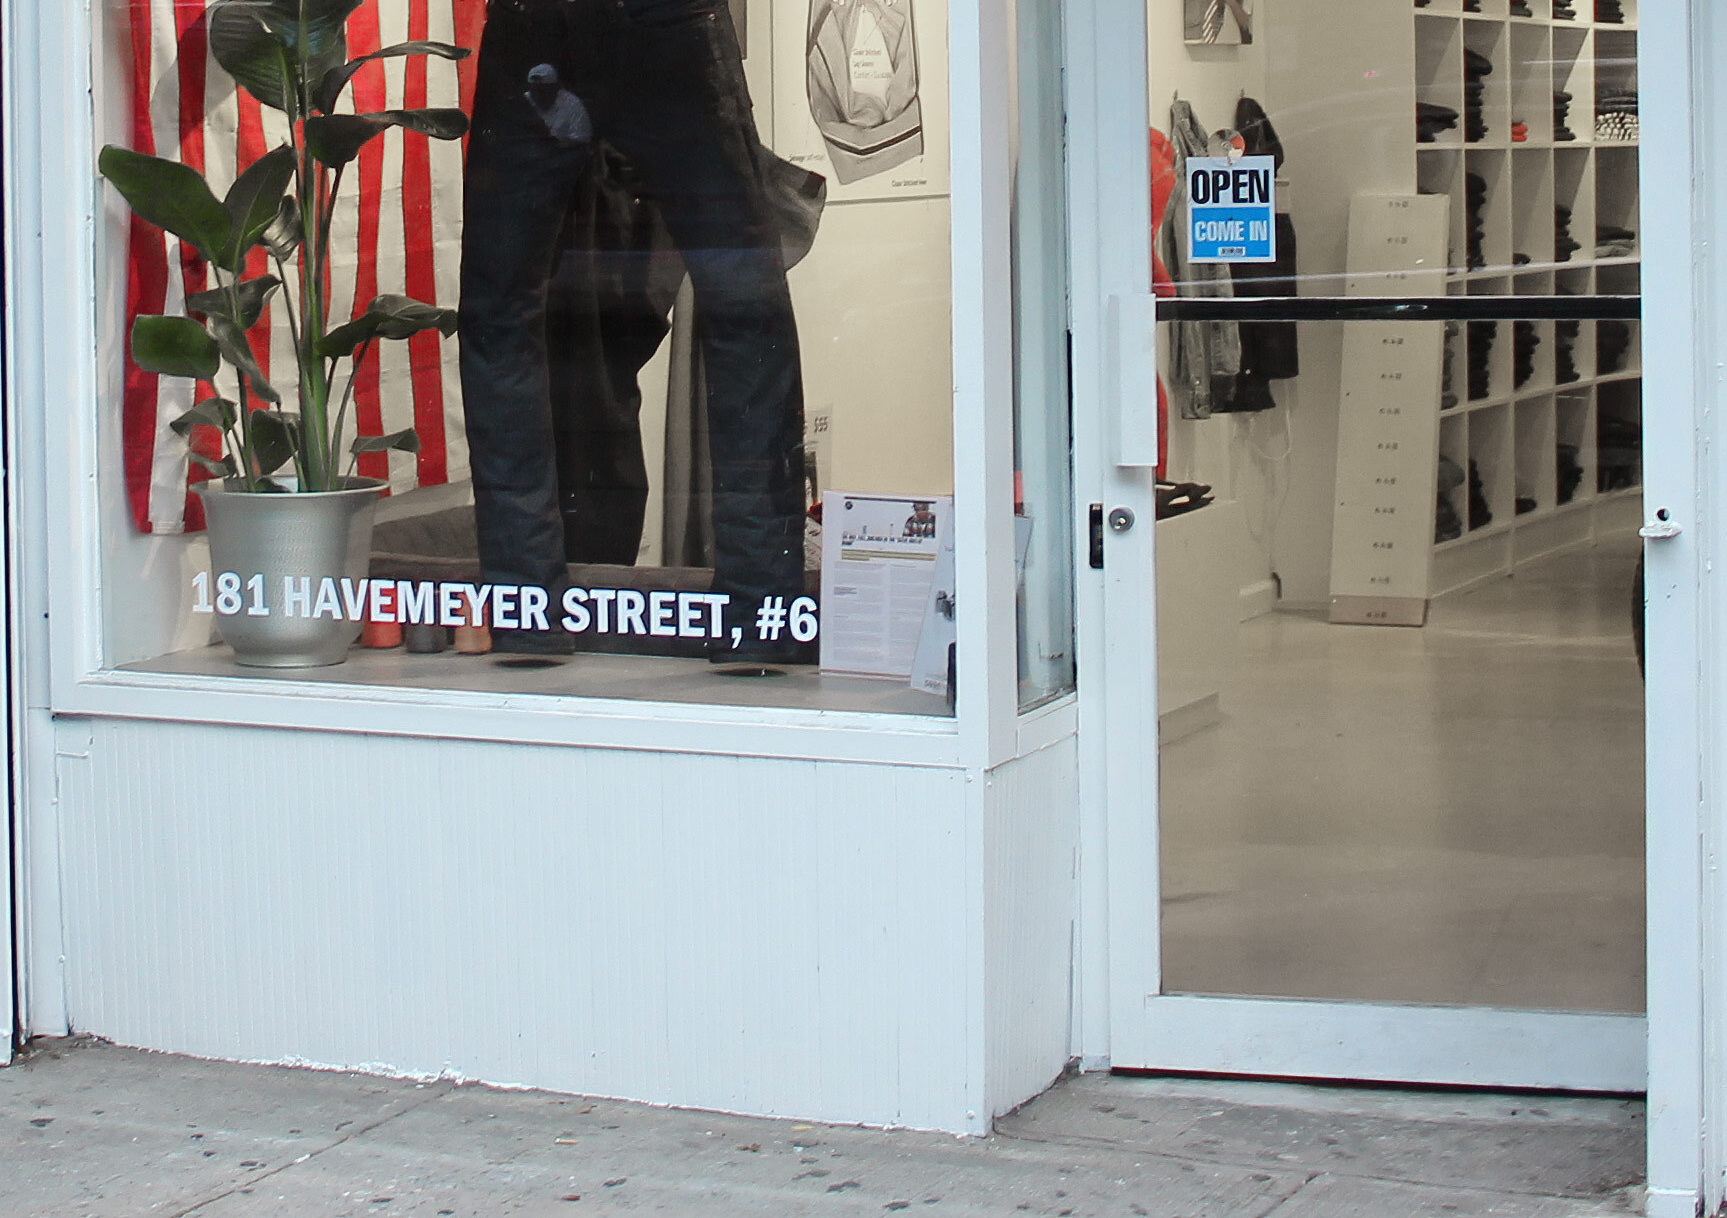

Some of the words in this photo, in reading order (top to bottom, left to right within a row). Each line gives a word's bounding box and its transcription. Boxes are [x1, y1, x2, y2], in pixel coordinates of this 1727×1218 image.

[1191, 169, 1270, 205] OPEN
[1195, 220, 1245, 242] COME
[1249, 220, 1268, 241] IN
[191, 570, 270, 617] 181
[285, 576, 549, 632] HAVEMEYER
[562, 588, 744, 651] STREET,
[755, 594, 818, 644] #6
